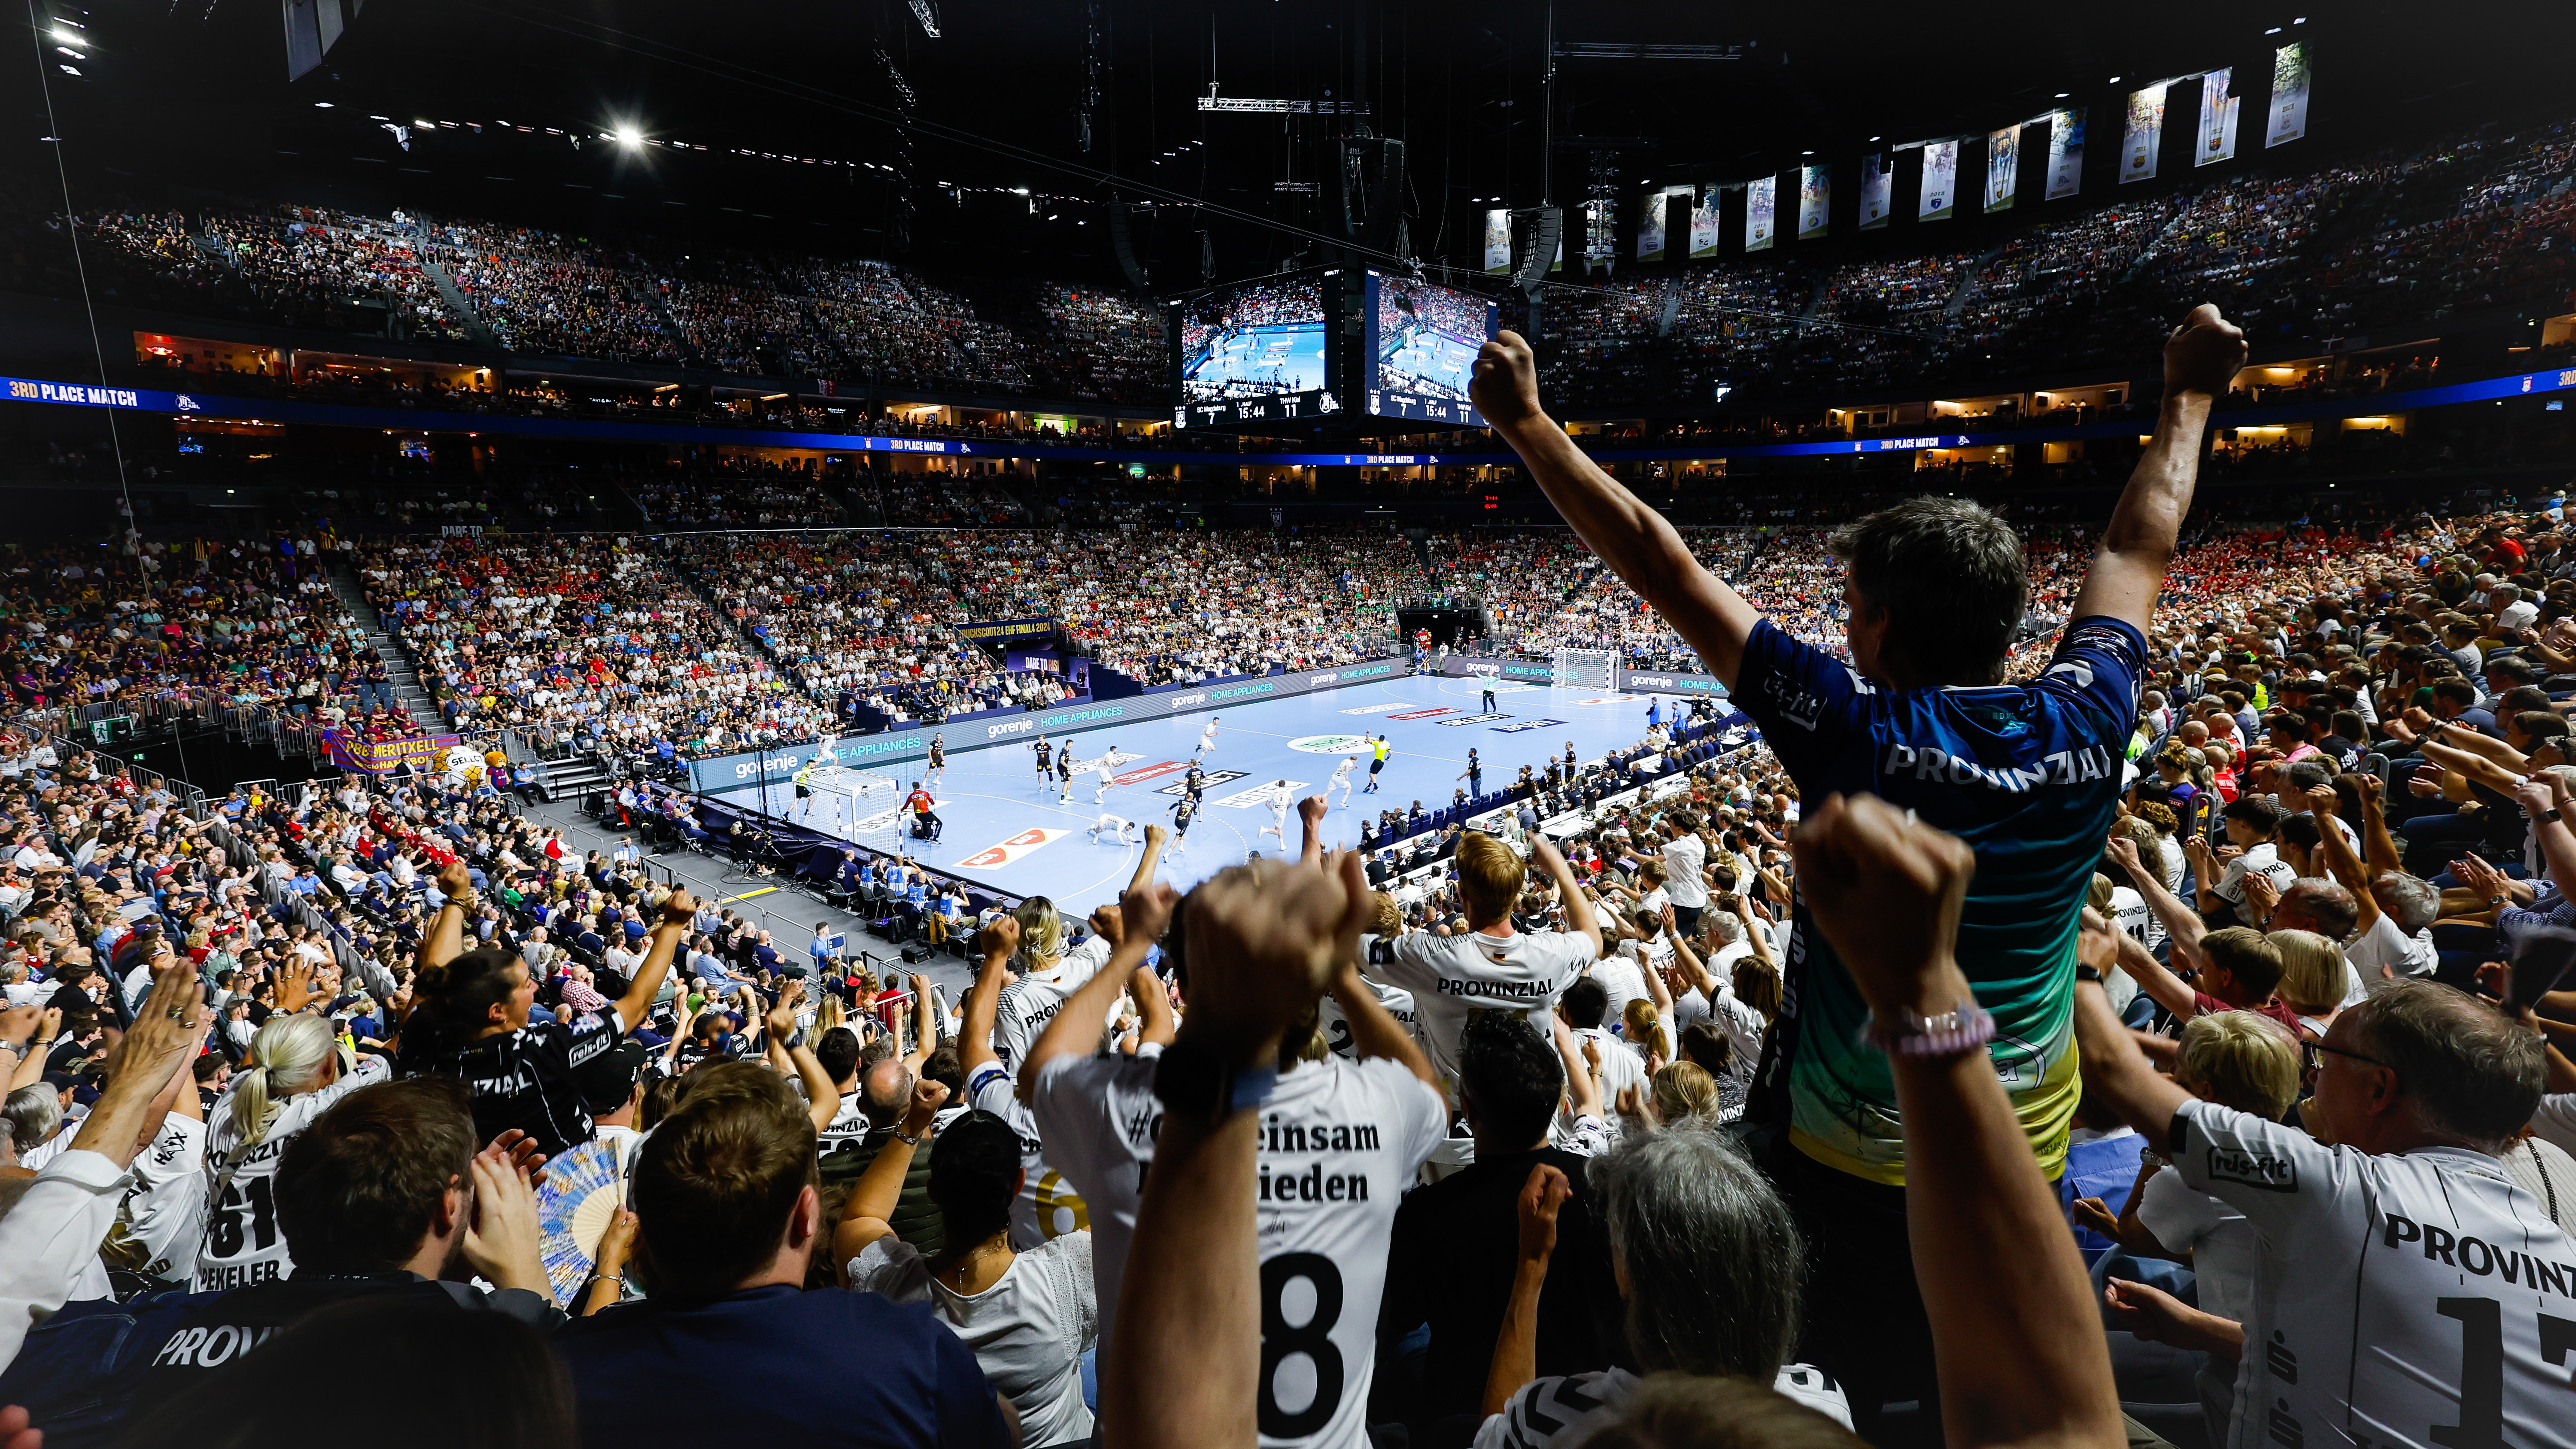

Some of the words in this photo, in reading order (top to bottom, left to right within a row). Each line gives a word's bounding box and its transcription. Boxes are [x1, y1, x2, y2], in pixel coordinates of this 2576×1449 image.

[9, 381, 39, 399] 3RD
[41, 383, 85, 403] PLACE
[87, 388, 138, 407] MATCH
[1279, 397, 1291, 405] THW
[1397, 395, 1416, 406] Magdeburg
[1203, 404, 1226, 413] Magdeburg
[1238, 405, 1265, 419] 15:44
[1284, 404, 1296, 417] 11
[1400, 404, 1407, 416] 7
[1426, 404, 1446, 418] 15:44
[1208, 413, 1215, 424] 7
[1460, 411, 1468, 423] 11
[890, 439, 903, 450] 3RD
[904, 440, 923, 450] PLACE
[924, 442, 945, 452] MATCH
[1880, 440, 1894, 450] 3RD
[1894, 439, 1914, 449] PLACE
[1915, 437, 1939, 448] MATCH
[1005, 626, 1015, 635] EHF
[1016, 623, 1035, 635] FINAL4
[1036, 622, 1051, 632] 2024
[1025, 656, 1040, 670] DARE
[1040, 658, 1048, 671] TO
[1466, 662, 1500, 674] gorenje
[1506, 666, 1529, 675] HOME
[1530, 668, 1578, 679] APPLINES
[1310, 671, 1337, 687] gorenje
[1341, 671, 1358, 680] HOME
[1358, 665, 1391, 679] APPLIANCES
[1631, 675, 1673, 688] gorenje
[1680, 680, 1708, 690] HOME
[1172, 692, 1206, 709] gorenje
[1211, 689, 1232, 701] HOME
[1233, 683, 1273, 699] APPLIANCES
[988, 717, 1033, 738] gorenje
[1041, 714, 1069, 727] HOME
[1069, 706, 1123, 723] APPLIANCES
[1441, 713, 1509, 726] SELECT
[373, 738, 439, 758] MERITXELL
[1301, 738, 1352, 747] Truck
[1314, 738, 1379, 753] Scout2
[380, 756, 430, 769] HANBO
[452, 755, 483, 766] SELECT
[735, 753, 798, 779] gorenje
[808, 748, 847, 765] HME
[849, 737, 922, 759] APPLIANCES
[1162, 771, 1243, 796] SECT
[1011, 834, 1038, 845] MOL
[969, 853, 999, 865] MOL
[1437, 978, 1554, 996] PROVINZIAL
[573, 1033, 608, 1061] reis-fit
[209, 1176, 276, 1258] 61
[1256, 1252, 1345, 1439] 8
